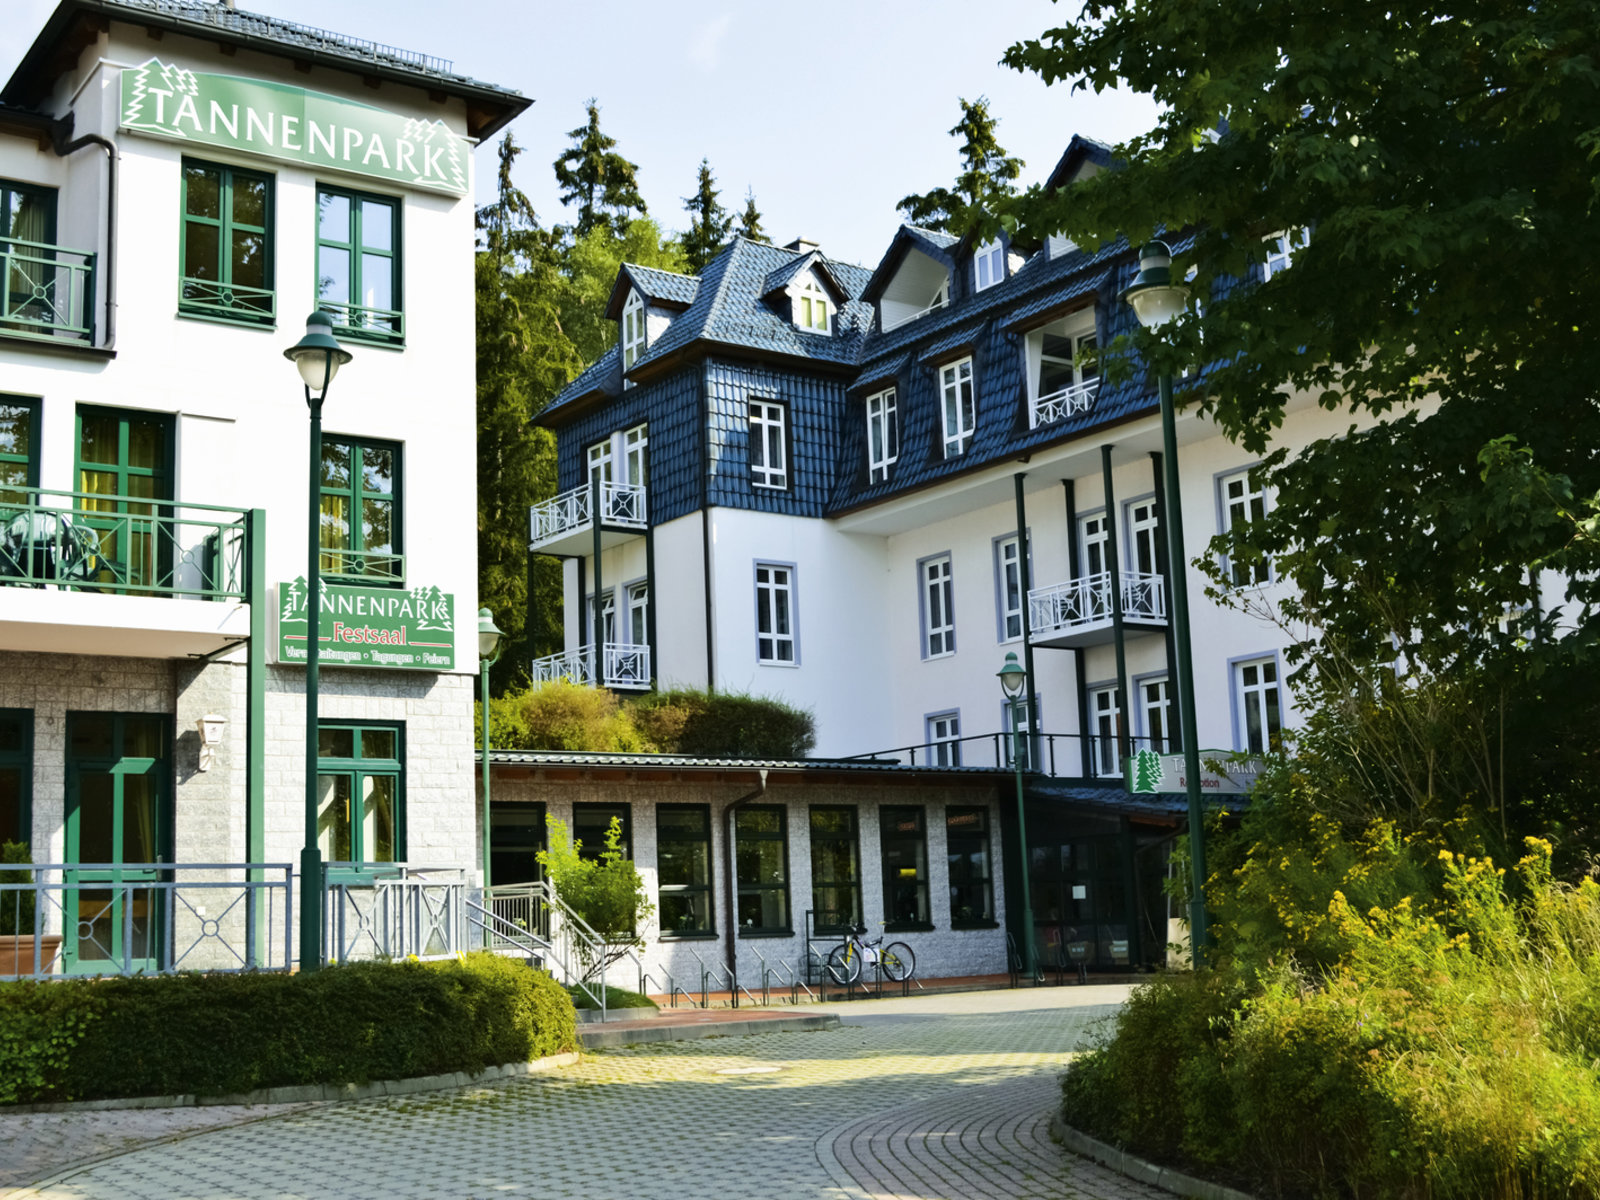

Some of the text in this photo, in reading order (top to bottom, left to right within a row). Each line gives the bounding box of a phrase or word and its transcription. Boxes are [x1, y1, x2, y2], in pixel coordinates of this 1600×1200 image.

[147, 87, 448, 181] TANNENPARK
[332, 621, 408, 646] Festsaal
[370, 650, 414, 665] Tagungen
[422, 653, 451, 665] Feiern
